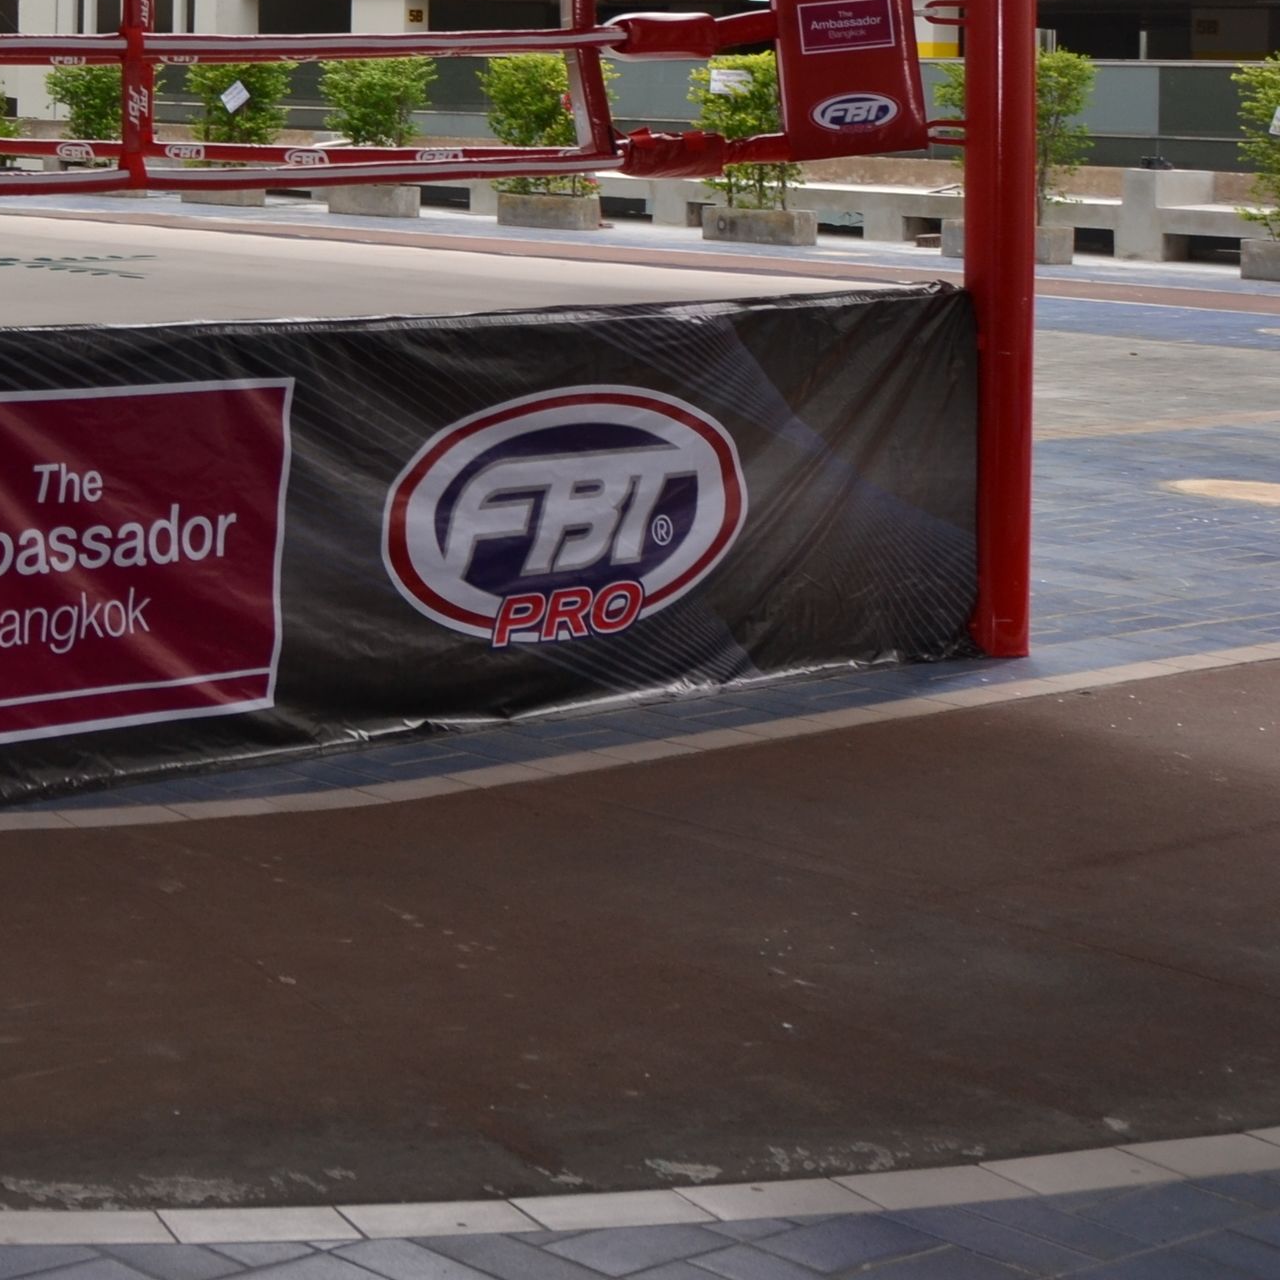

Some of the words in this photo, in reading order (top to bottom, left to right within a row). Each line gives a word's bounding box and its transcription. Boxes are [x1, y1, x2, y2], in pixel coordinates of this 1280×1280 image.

[810, 16, 882, 31] Ambassador
[34, 463, 103, 504] The
[444, 444, 698, 581] FBT
[492, 580, 646, 650] PRO
